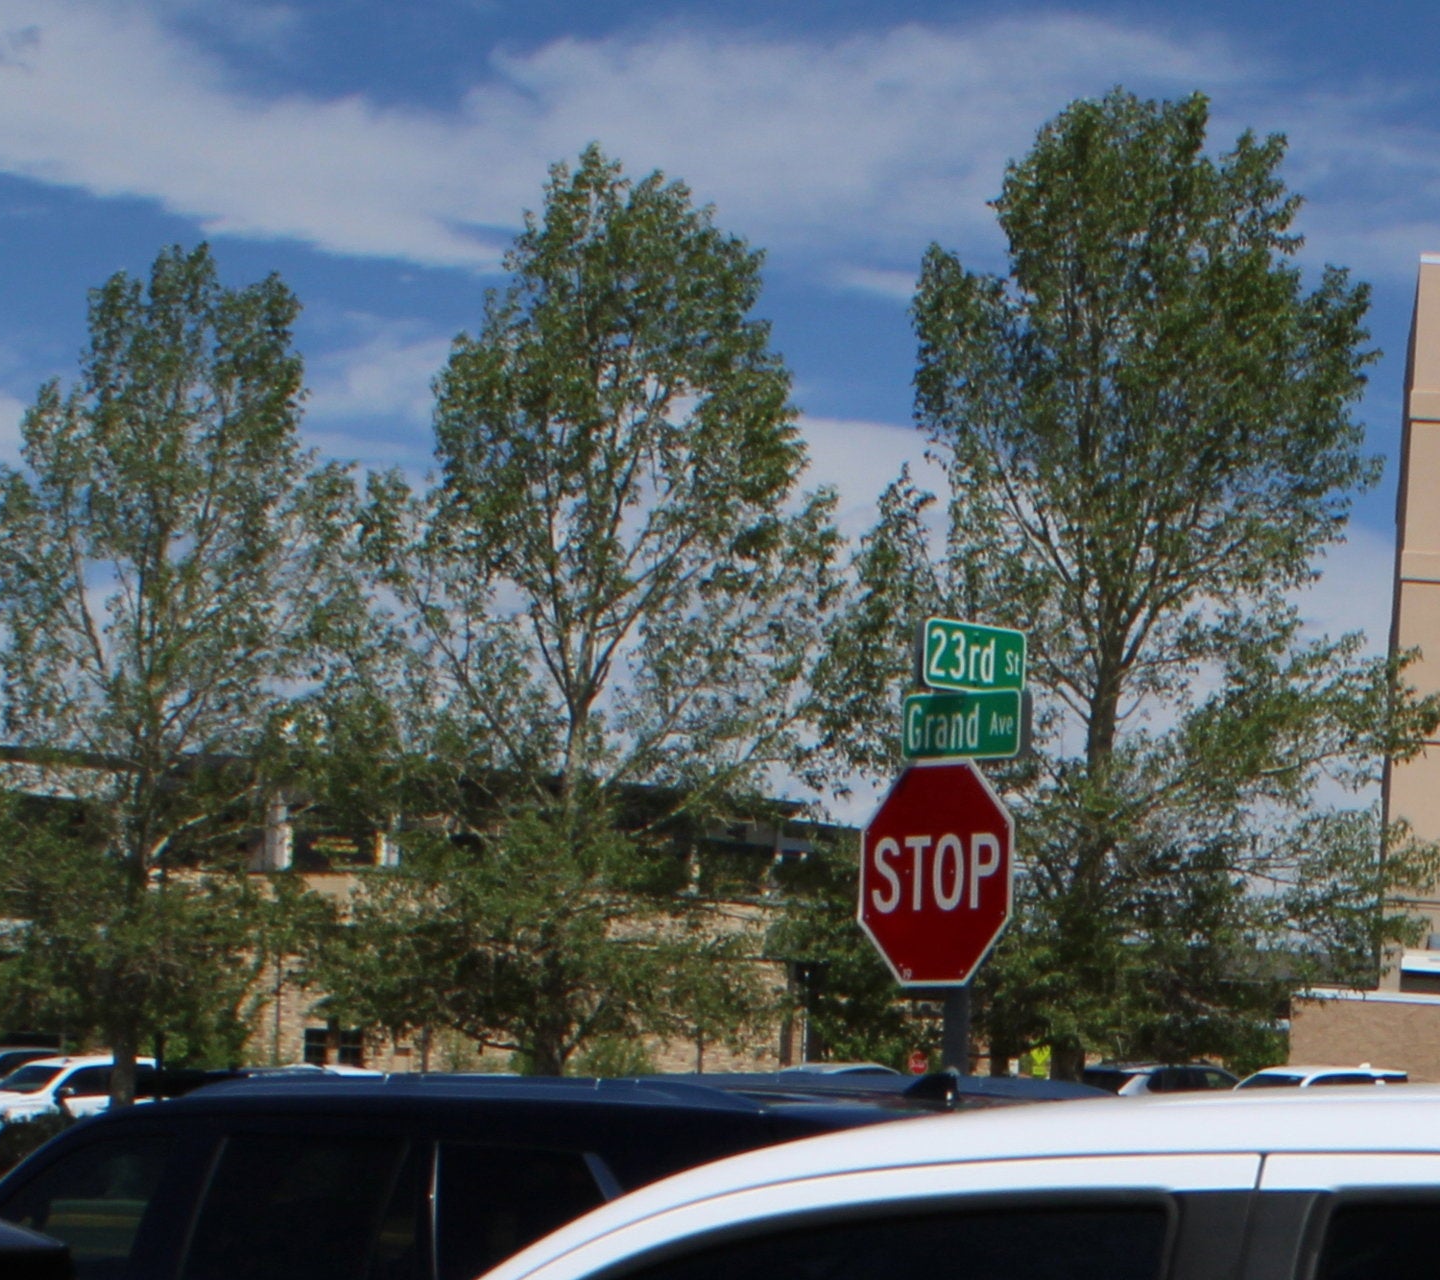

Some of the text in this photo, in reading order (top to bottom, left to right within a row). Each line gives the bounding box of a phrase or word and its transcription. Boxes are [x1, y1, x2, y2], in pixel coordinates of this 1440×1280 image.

[930, 627, 1020, 684] 23rd St
[907, 702, 1014, 751] Grand Ave
[871, 832, 1000, 914] STOP
